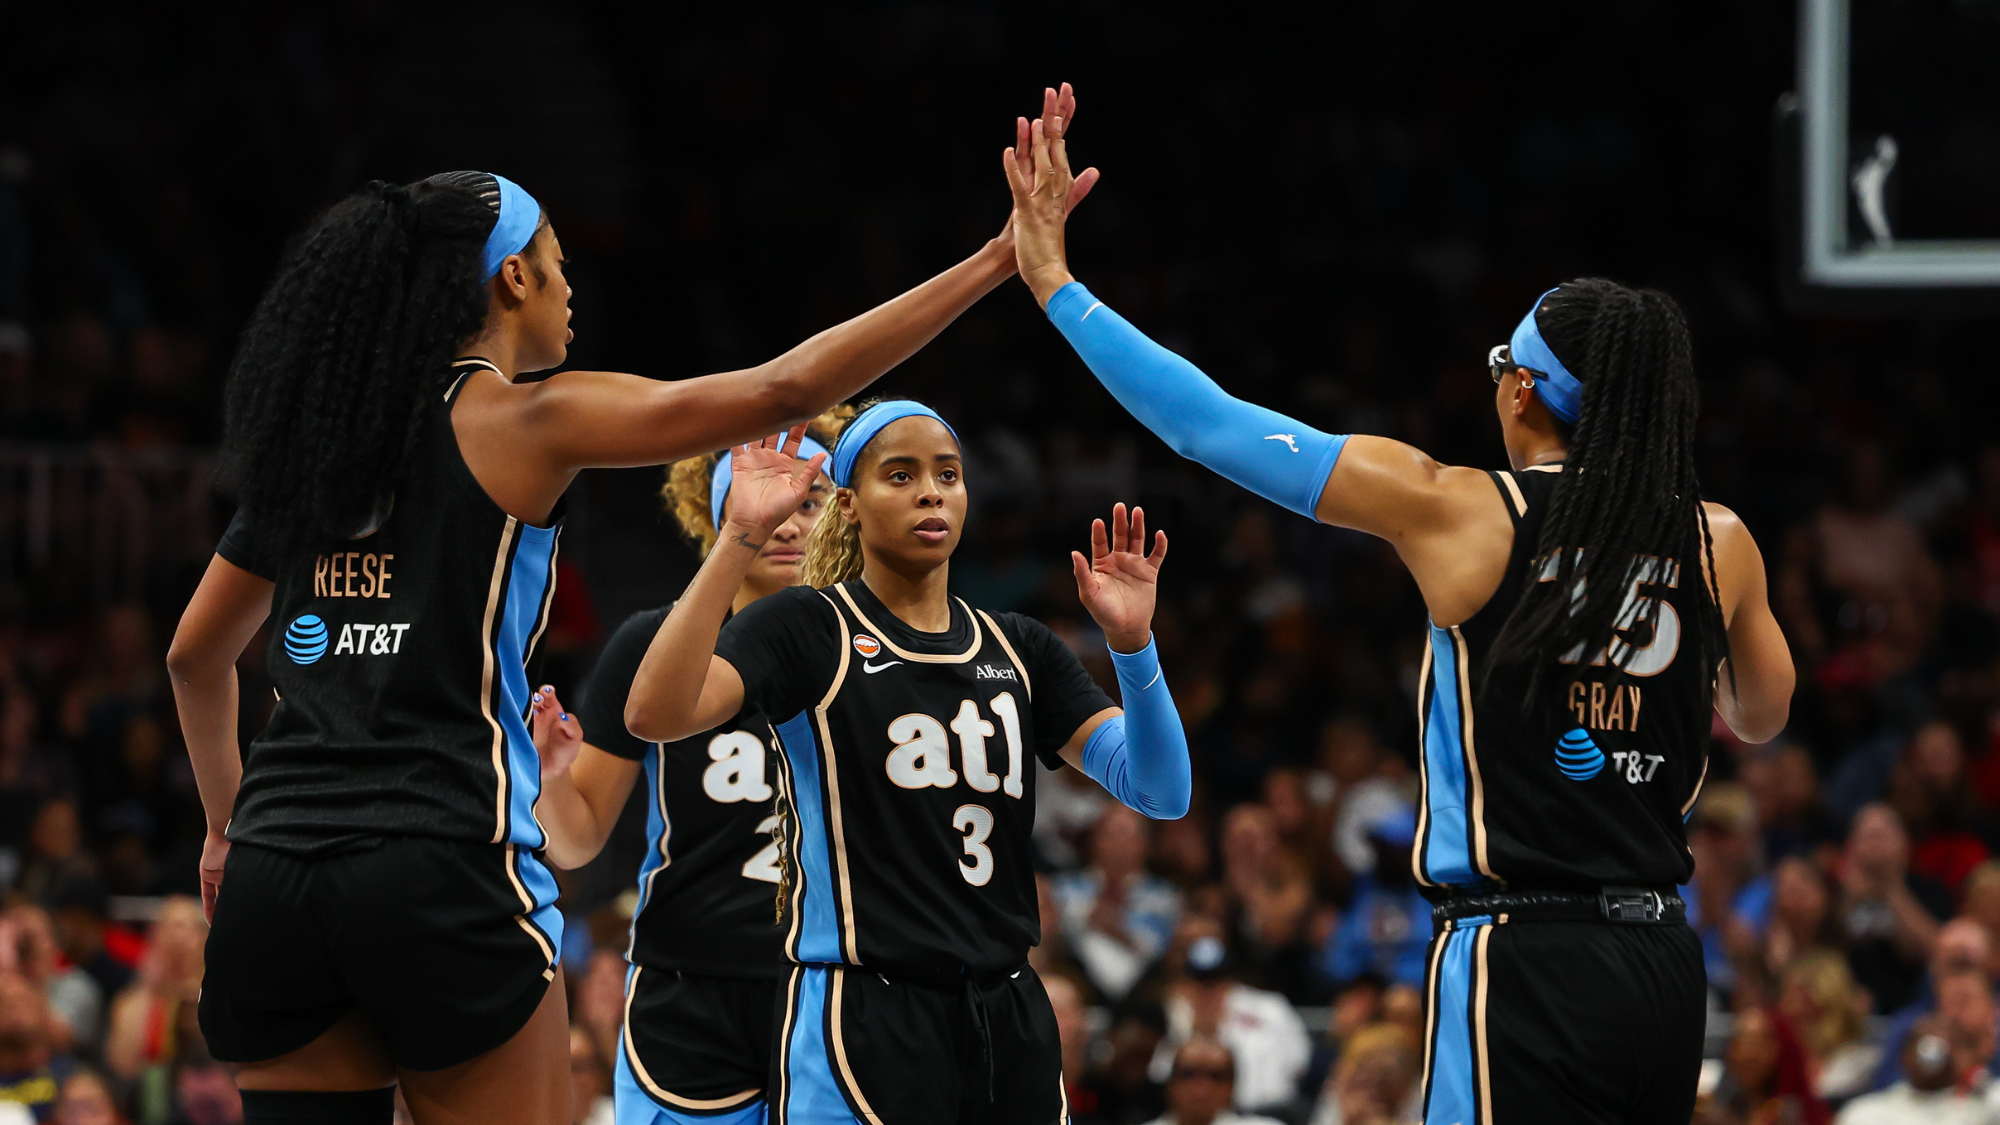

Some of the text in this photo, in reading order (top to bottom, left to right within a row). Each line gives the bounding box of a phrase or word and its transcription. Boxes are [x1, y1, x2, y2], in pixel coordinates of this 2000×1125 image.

[314, 552, 394, 599] REESE
[334, 623, 411, 656] AT&T
[976, 664, 1018, 683] Albert
[1569, 681, 1641, 732] GRAY
[886, 692, 1024, 800] atl
[1611, 750, 1665, 784] T&T
[952, 803, 994, 887] 3
